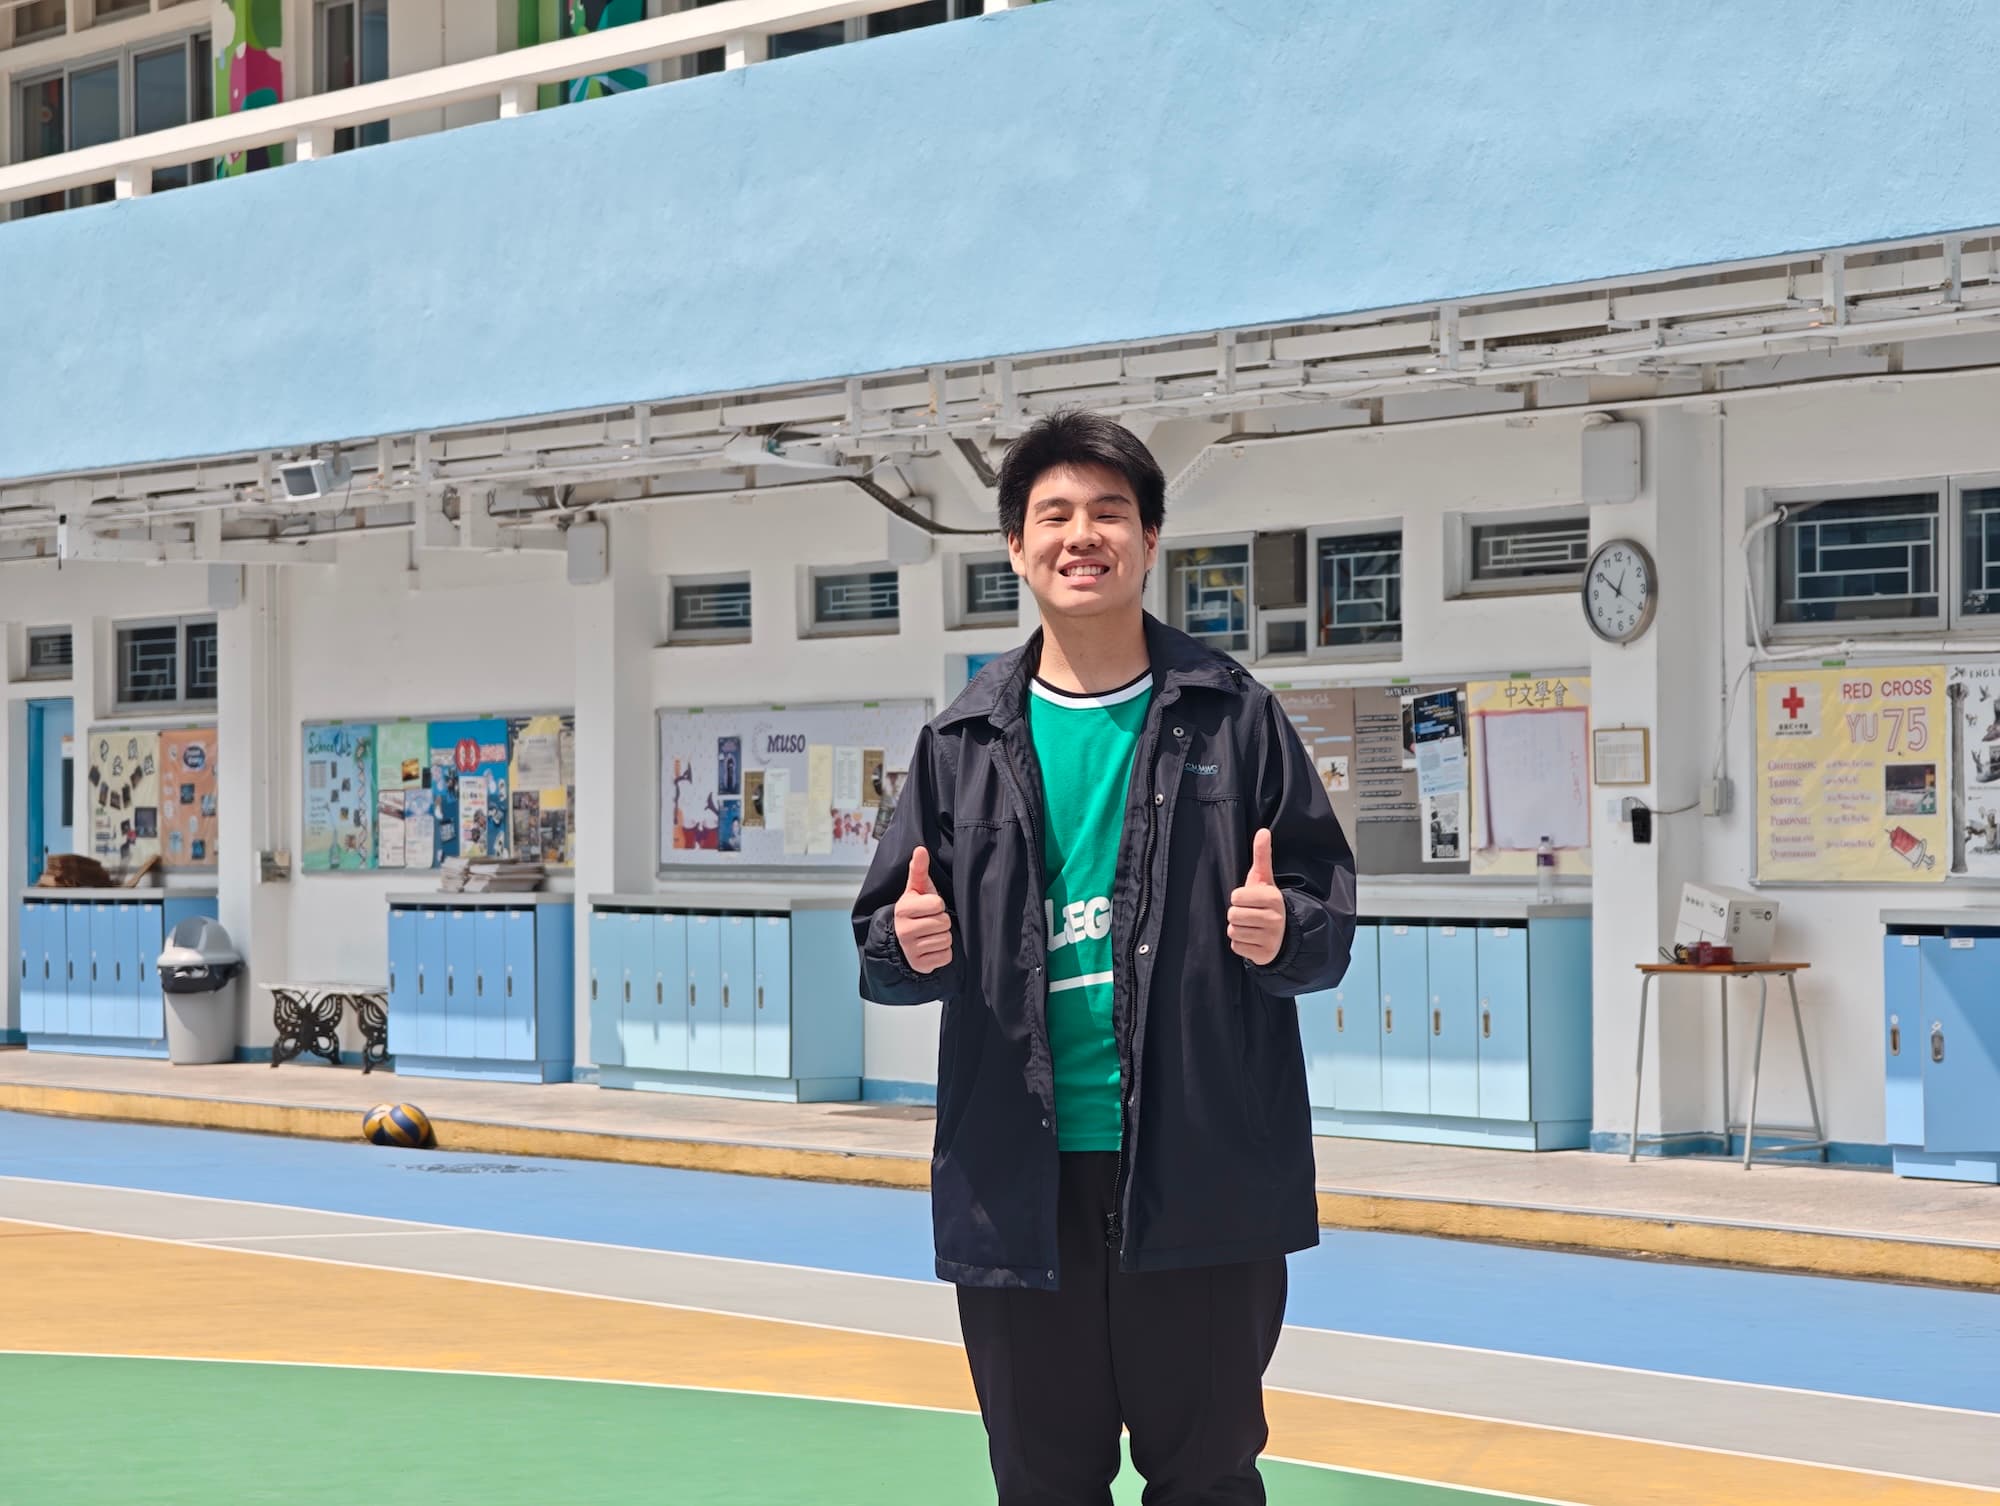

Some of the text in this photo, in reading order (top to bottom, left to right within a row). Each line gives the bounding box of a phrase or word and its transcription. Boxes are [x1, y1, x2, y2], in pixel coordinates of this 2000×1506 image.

[1614, 551, 1623, 562] 12
[1627, 555, 1632, 565] 1
[1603, 559, 1611, 568] 11
[1596, 572, 1604, 583] 10
[1636, 567, 1642, 578] 2
[1640, 583, 1646, 594] 3
[1593, 590, 1599, 600] 9
[1598, 606, 1603, 617] 8
[1637, 602, 1643, 611] 4
[1607, 617, 1612, 628] 7
[1629, 614, 1635, 625] 5
[1618, 620, 1624, 631] 6
[1504, 680, 1568, 708] 中文學會
[1843, 679, 1932, 699] RED CROSS
[767, 734, 806, 753] MUSO
[1044, 896, 1113, 953] LEG
